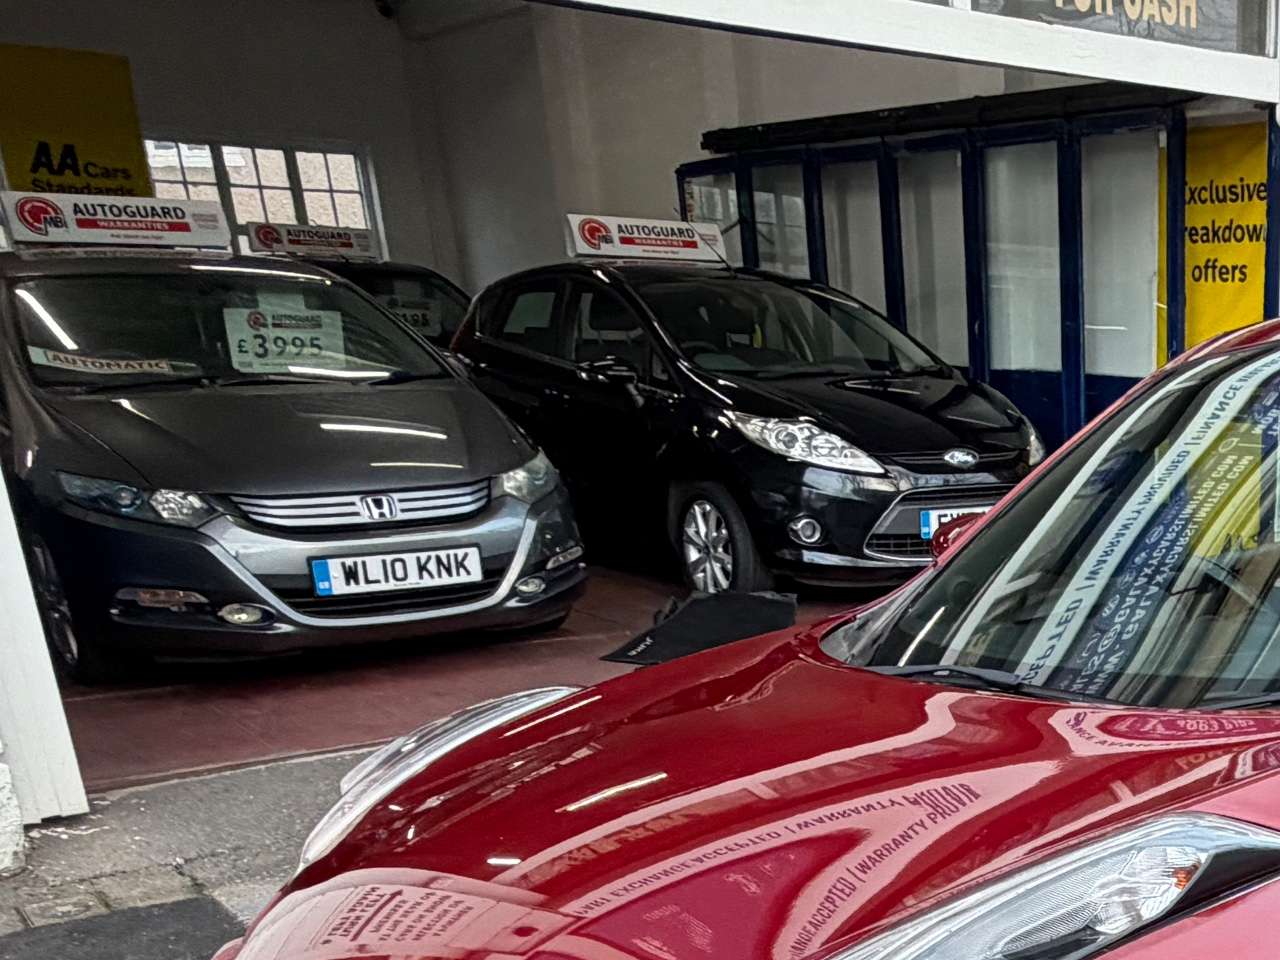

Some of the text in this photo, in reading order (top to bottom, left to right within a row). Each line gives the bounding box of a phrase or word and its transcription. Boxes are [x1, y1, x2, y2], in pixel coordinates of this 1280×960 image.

[1123, 0, 1197, 29] CASH
[30, 141, 132, 180] AA Cars
[1184, 177, 1267, 205] xclusive
[73, 203, 186, 219] AUTOGUARD
[617, 223, 696, 239] AUTOGUARD
[1192, 258, 1248, 283] offers
[50, 352, 168, 371] AUTOMATIC
[341, 552, 472, 587] WL10 KNK
[855, 819, 929, 876] WARRANTY
